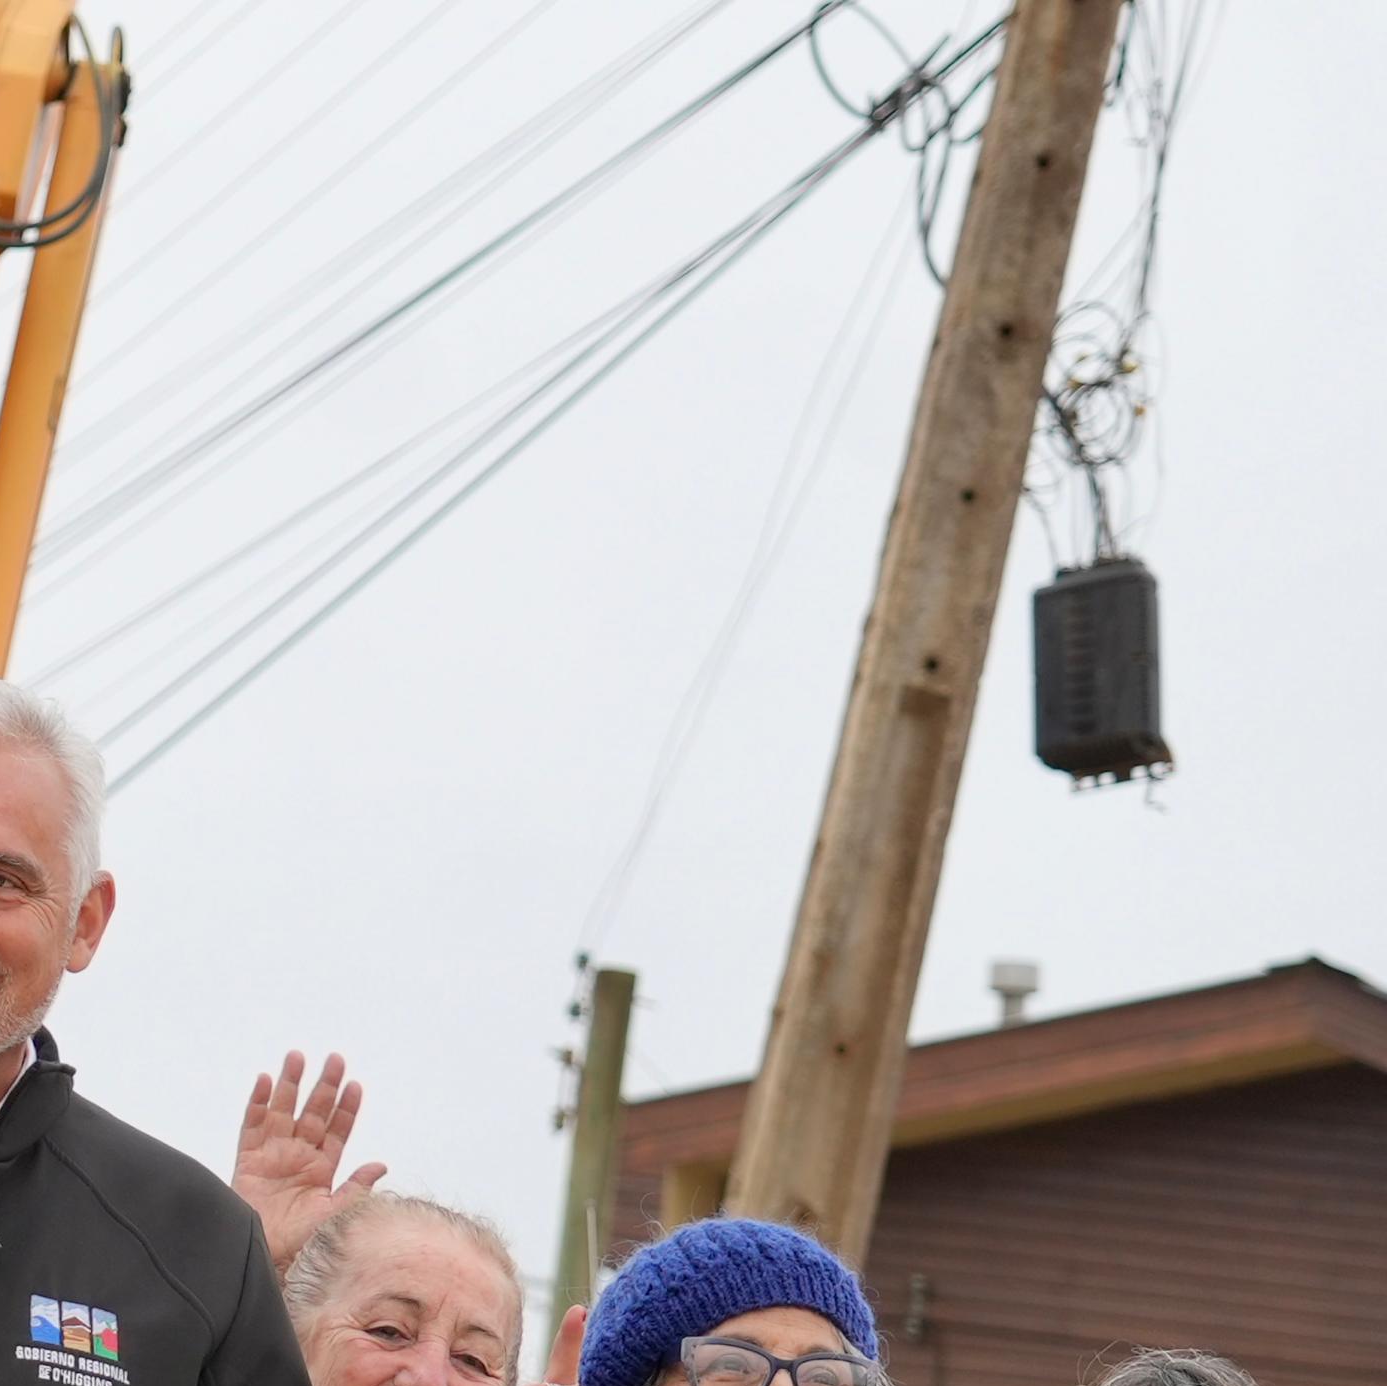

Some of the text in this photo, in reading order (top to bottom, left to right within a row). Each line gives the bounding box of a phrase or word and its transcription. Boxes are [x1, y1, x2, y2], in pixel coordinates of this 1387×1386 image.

[15, 1345, 131, 1385] GOBIERNO REGIONAL
[38, 1364, 52, 1380] DE
